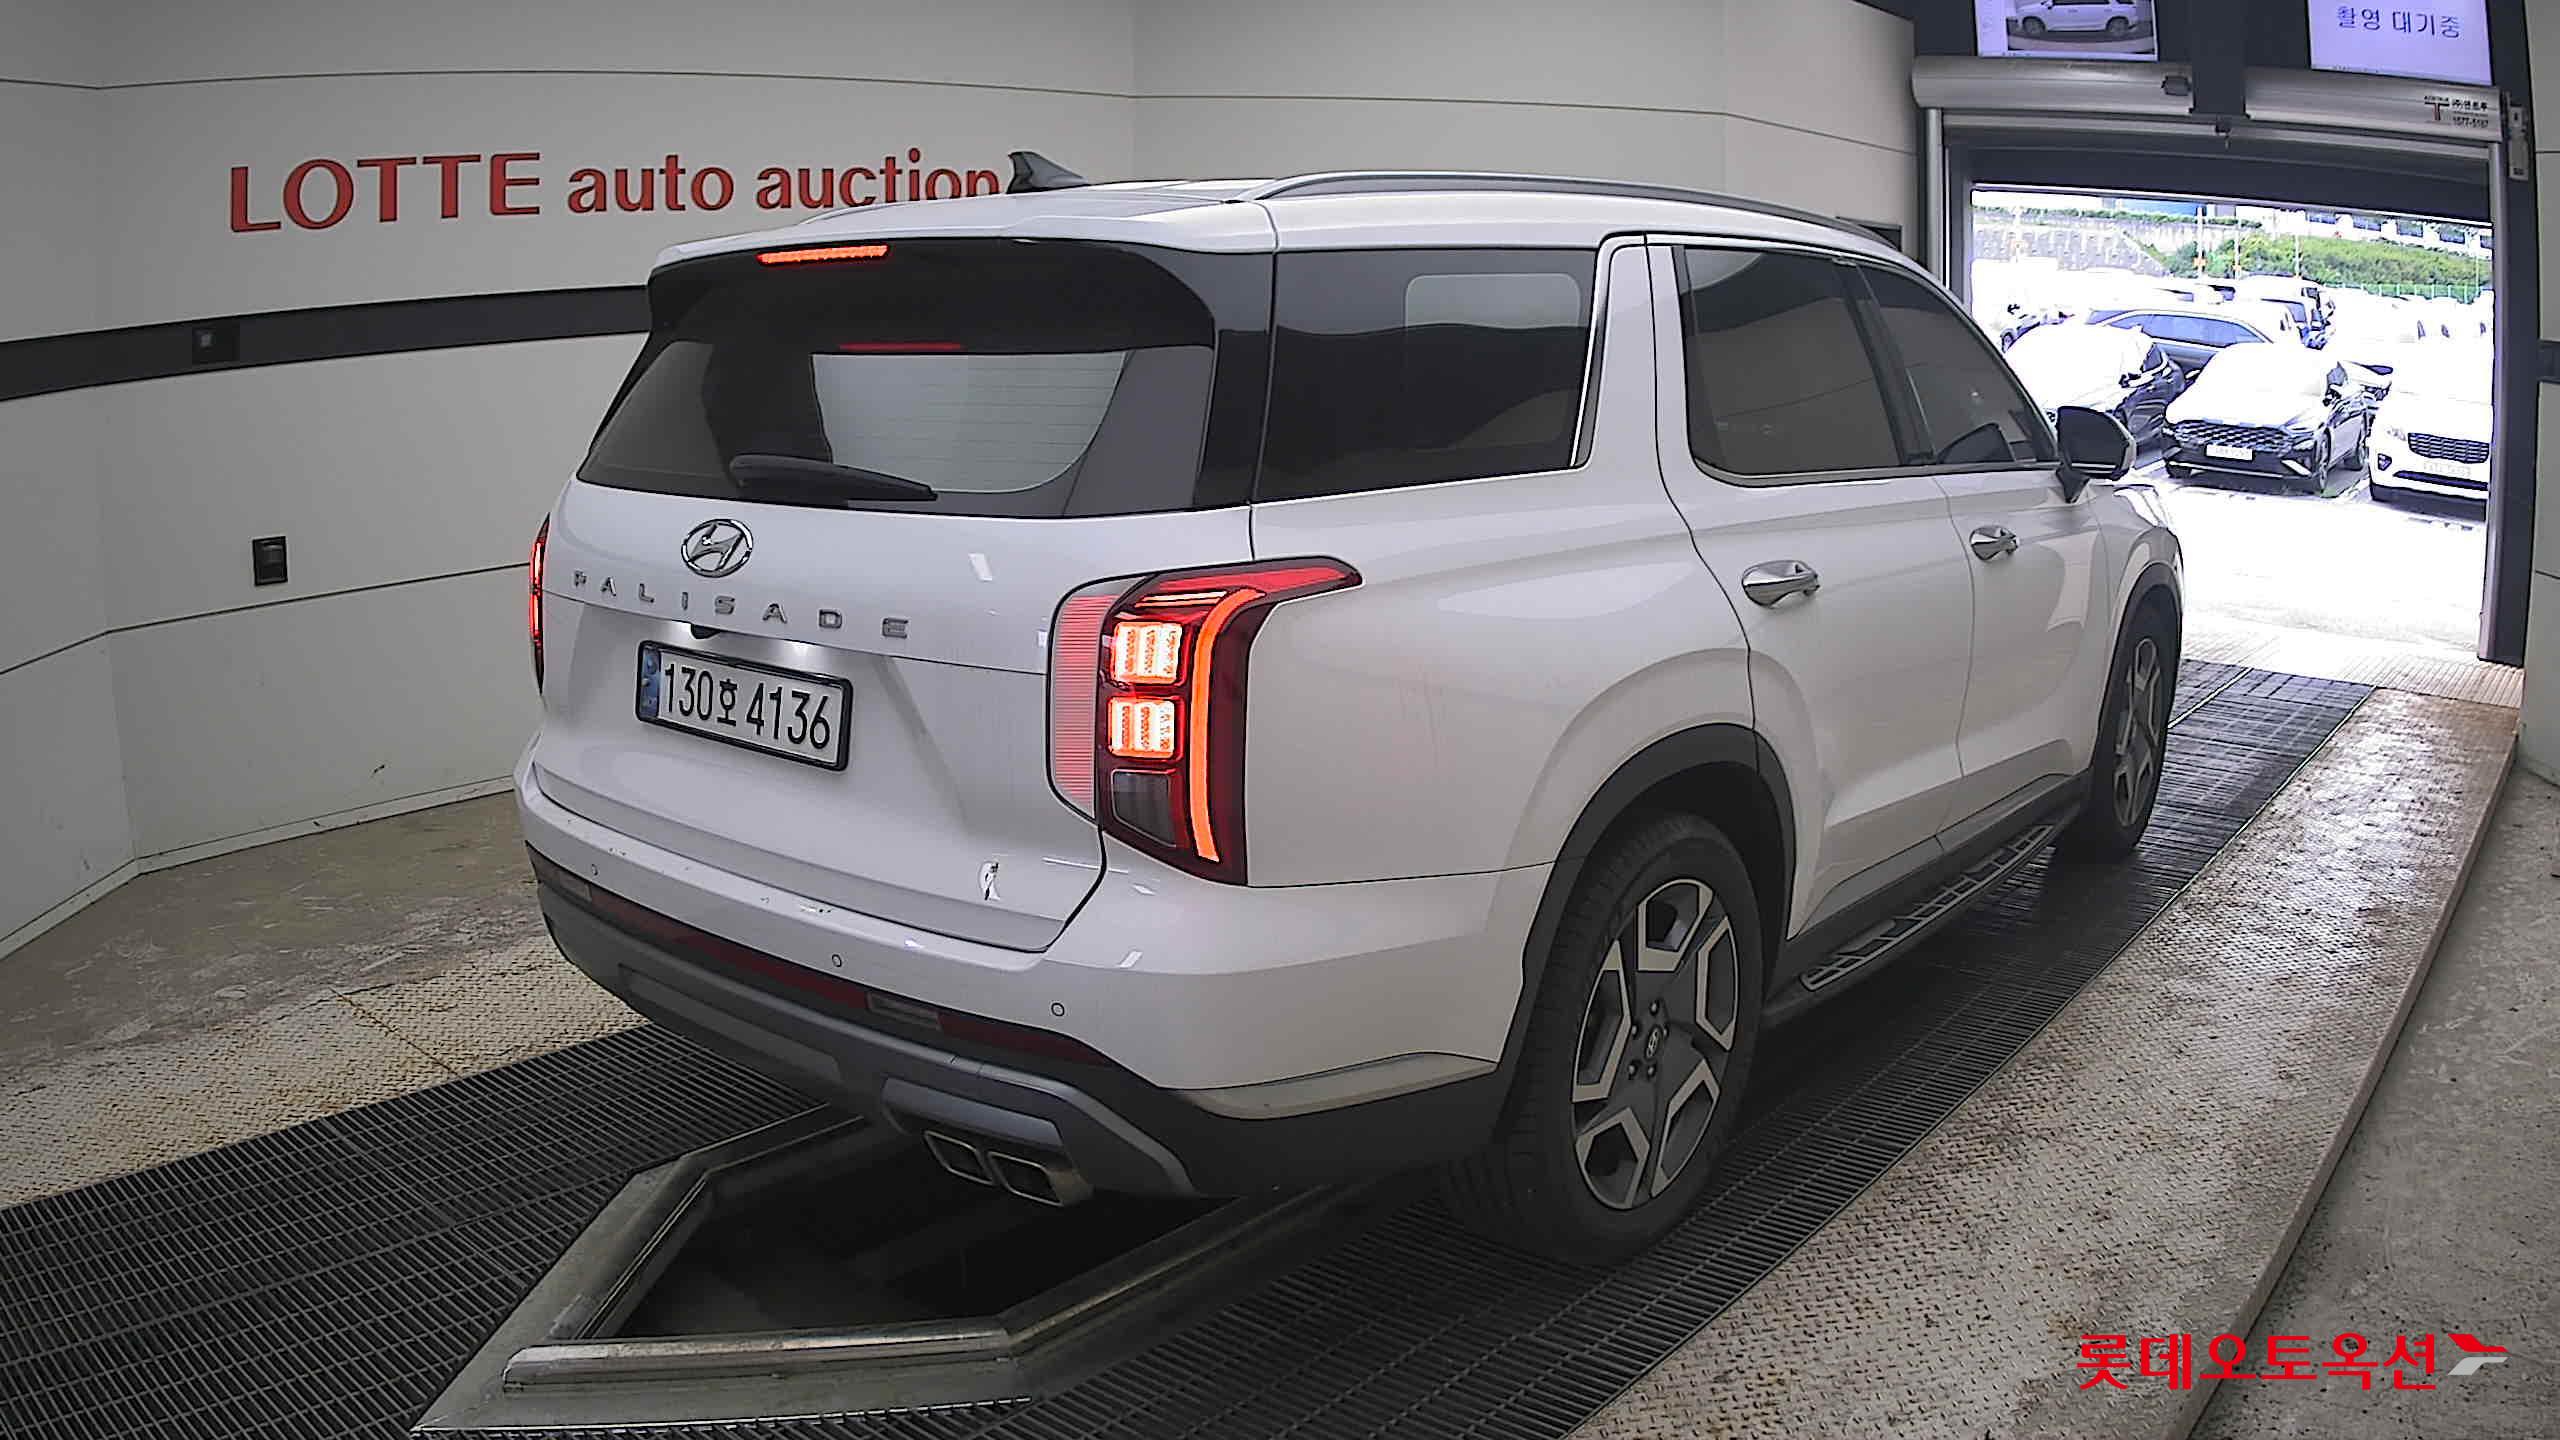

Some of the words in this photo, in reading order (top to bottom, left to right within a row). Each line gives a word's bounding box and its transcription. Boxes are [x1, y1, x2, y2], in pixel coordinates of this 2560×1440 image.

[2338, 6, 2381, 31] 촬영
[2392, 11, 2460, 38] 대기중
[231, 152, 540, 232] LOTTE
[568, 154, 735, 213] auto
[756, 147, 999, 209] auction
[573, 570, 909, 639] PALISADE
[664, 663, 738, 727] 130호
[746, 683, 831, 749] 4136
